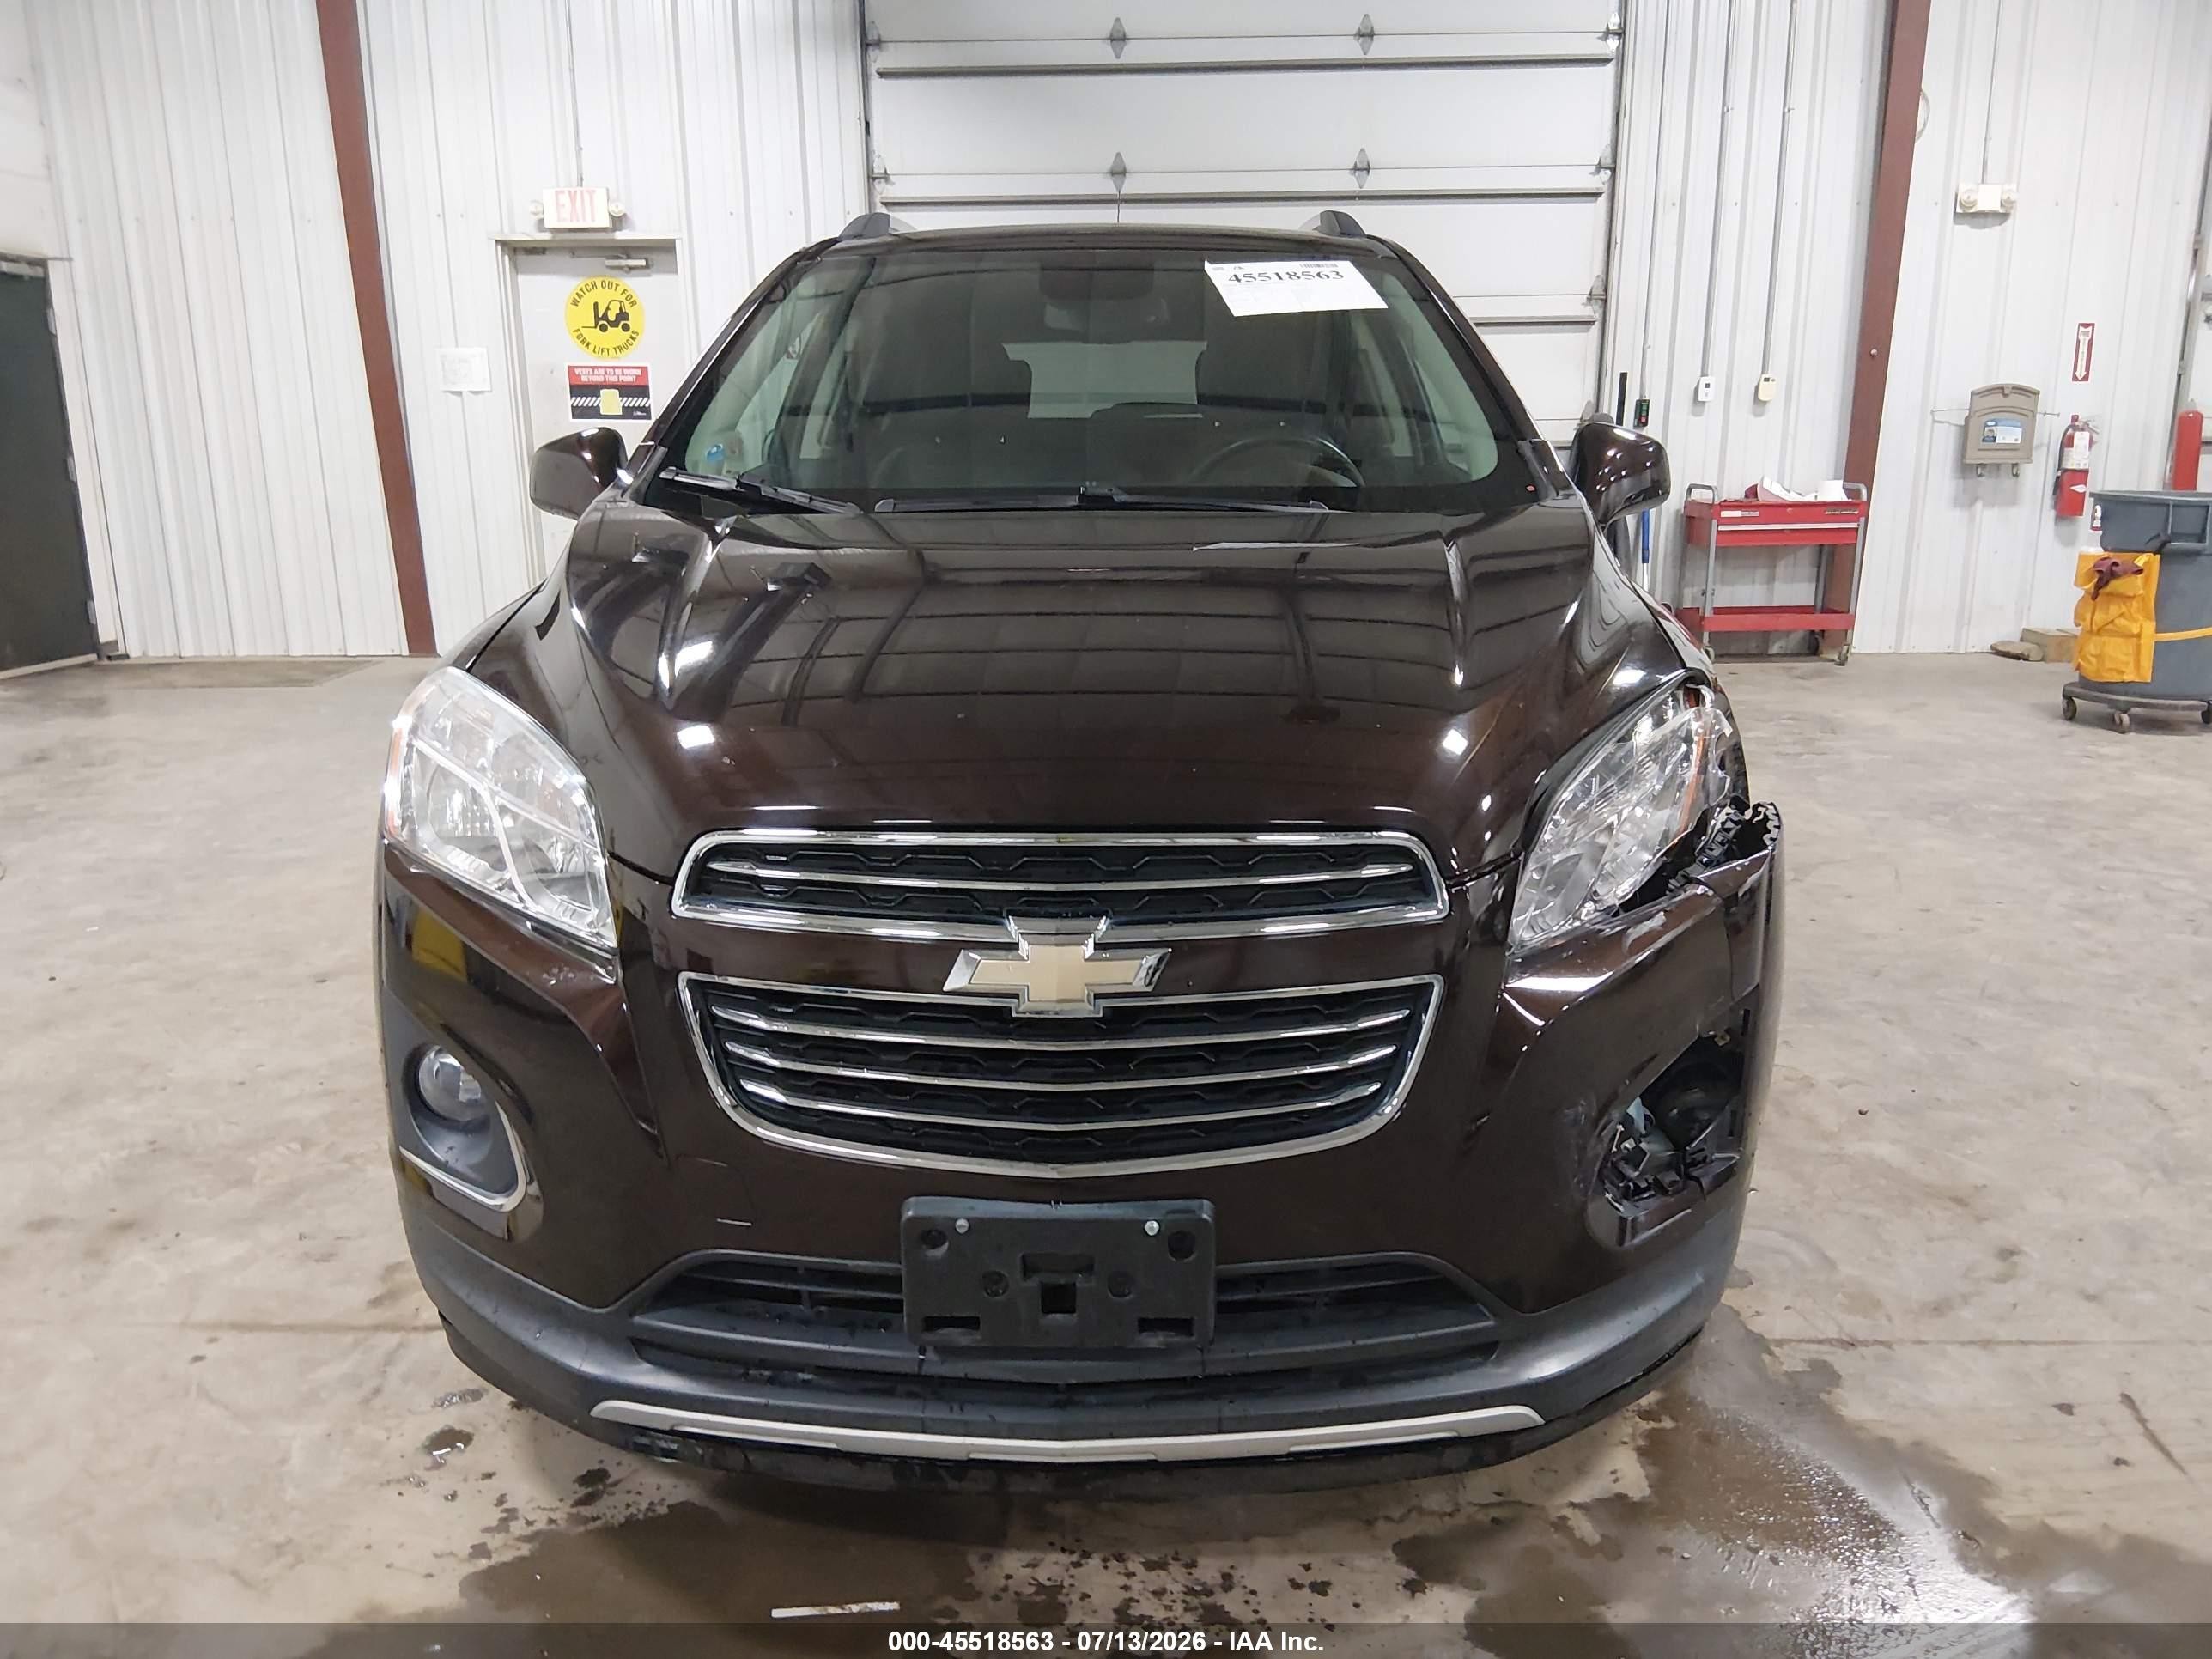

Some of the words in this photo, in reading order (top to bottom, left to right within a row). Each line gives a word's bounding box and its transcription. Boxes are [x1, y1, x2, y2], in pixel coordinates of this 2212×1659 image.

[556, 190, 596, 222] EXIT
[1228, 270, 1345, 283] 45518563
[570, 281, 598, 307] WATCH
[601, 280, 620, 291] OUT
[620, 289, 638, 307] FOR
[572, 328, 591, 349] FORK
[592, 345, 610, 356] LIFT
[612, 330, 640, 356] TRUCKS
